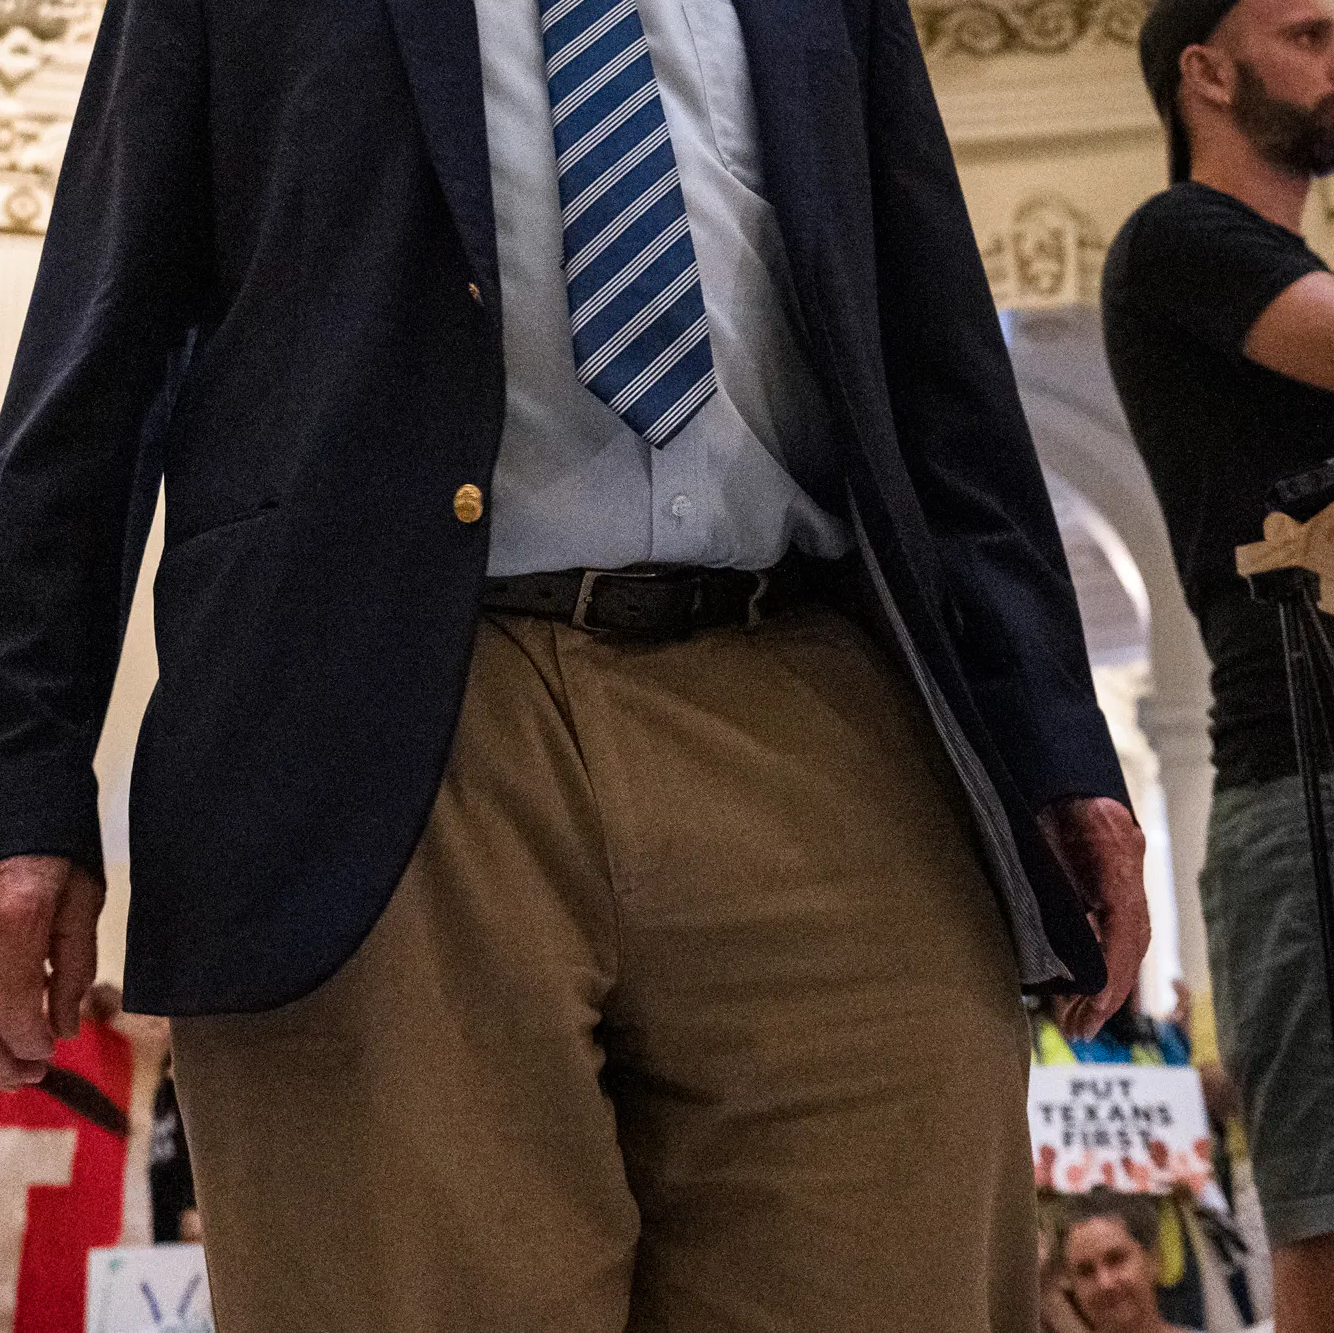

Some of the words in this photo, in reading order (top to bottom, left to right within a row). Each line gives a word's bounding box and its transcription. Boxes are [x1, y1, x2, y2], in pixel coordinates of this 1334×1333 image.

[1070, 1078, 1133, 1099] PUT
[1039, 1101, 1173, 1127] TEXANS
[1063, 1127, 1153, 1153] FIRST
